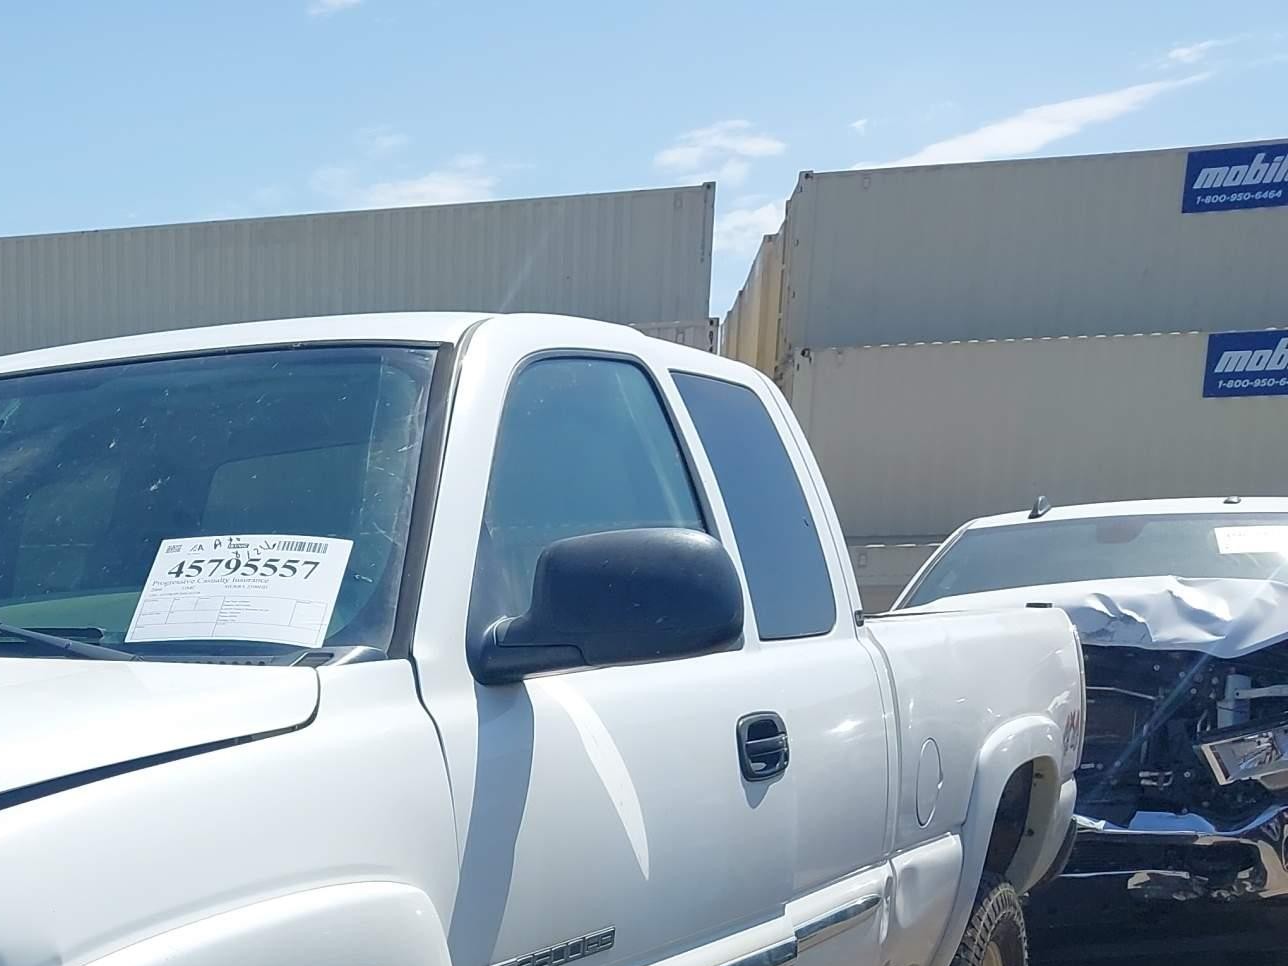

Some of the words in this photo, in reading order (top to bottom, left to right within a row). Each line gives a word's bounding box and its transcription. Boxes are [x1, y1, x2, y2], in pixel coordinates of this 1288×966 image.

[1193, 153, 1288, 188] mobil
[1196, 190, 1282, 204] 1-800-950-6464
[1218, 378, 1288, 389] 1-800-950-6
[167, 557, 321, 580] 45795557
